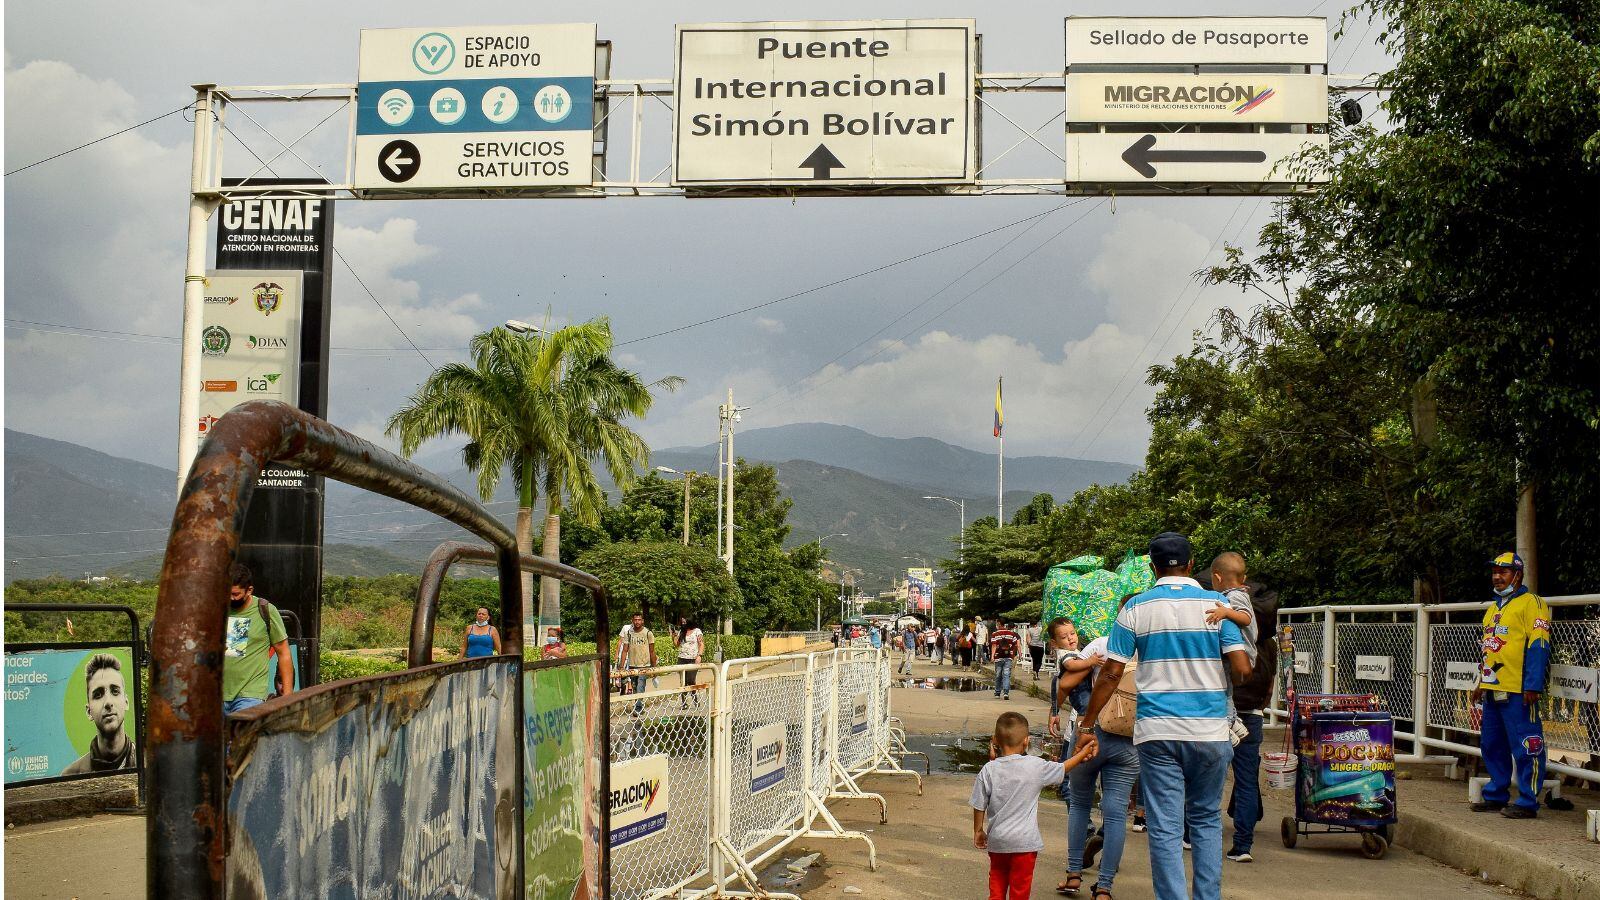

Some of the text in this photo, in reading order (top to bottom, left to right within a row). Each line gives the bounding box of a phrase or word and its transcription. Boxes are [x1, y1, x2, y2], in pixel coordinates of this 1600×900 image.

[465, 36, 530, 51] ESPACIO
[1089, 30, 1309, 49] Sellado de Pasaporte
[757, 37, 890, 59] Puente
[464, 53, 541, 68] DE APOYO
[694, 72, 946, 99] Internacional
[1104, 82, 1254, 102] MIGRACIÓN
[691, 110, 955, 137] Simón Bolívar
[463, 141, 565, 158] SERVICIOS
[457, 161, 569, 178] GRATUITOS
[223, 199, 322, 230] CENAF
[260, 234, 302, 242] NACIONAL
[221, 243, 319, 252] ATENCIÓN EN FRONTERAS
[258, 338, 288, 348] DIAN
[247, 377, 268, 391] ica
[257, 479, 302, 487] SANTANDER
[8, 671, 48, 687] pierdes
[1553, 676, 1587, 689] MIGRACIÓN
[1330, 763, 1363, 772] SANGRE
[419, 845, 452, 899] ACNUR
